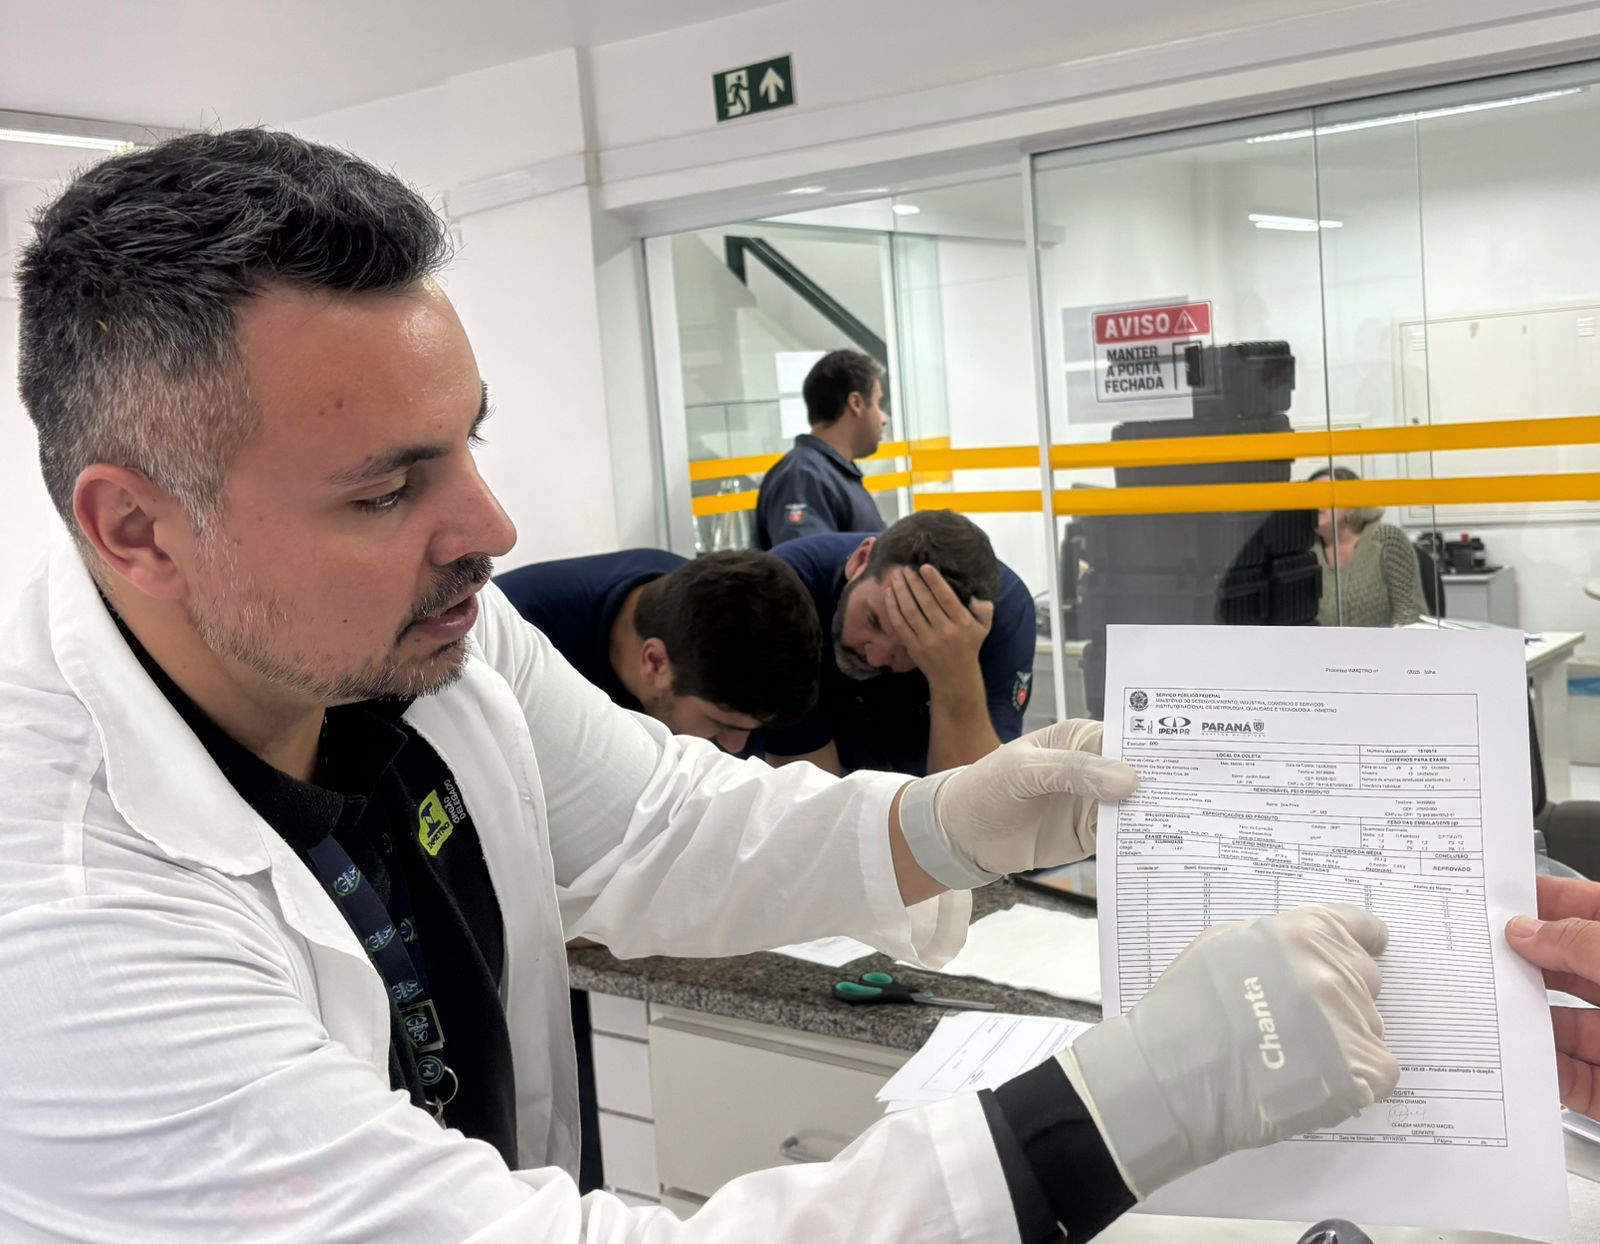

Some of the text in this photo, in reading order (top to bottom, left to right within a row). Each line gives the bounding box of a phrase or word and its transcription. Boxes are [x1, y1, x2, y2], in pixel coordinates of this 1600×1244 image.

[1105, 313, 1170, 339] AVISO
[1107, 345, 1158, 361] MANTER
[1107, 362, 1161, 377] A PORTA
[1105, 376, 1165, 393] FECHADA
[1202, 722, 1251, 732] PARANÁ
[443, 779, 467, 820] DELEGADO
[1202, 811, 1244, 819] ESPECIFICAÇÕES
[1291, 864, 1329, 873] ENCONTRADAS
[1244, 976, 1285, 1069] Chanta
[413, 1031, 428, 1042] 50
